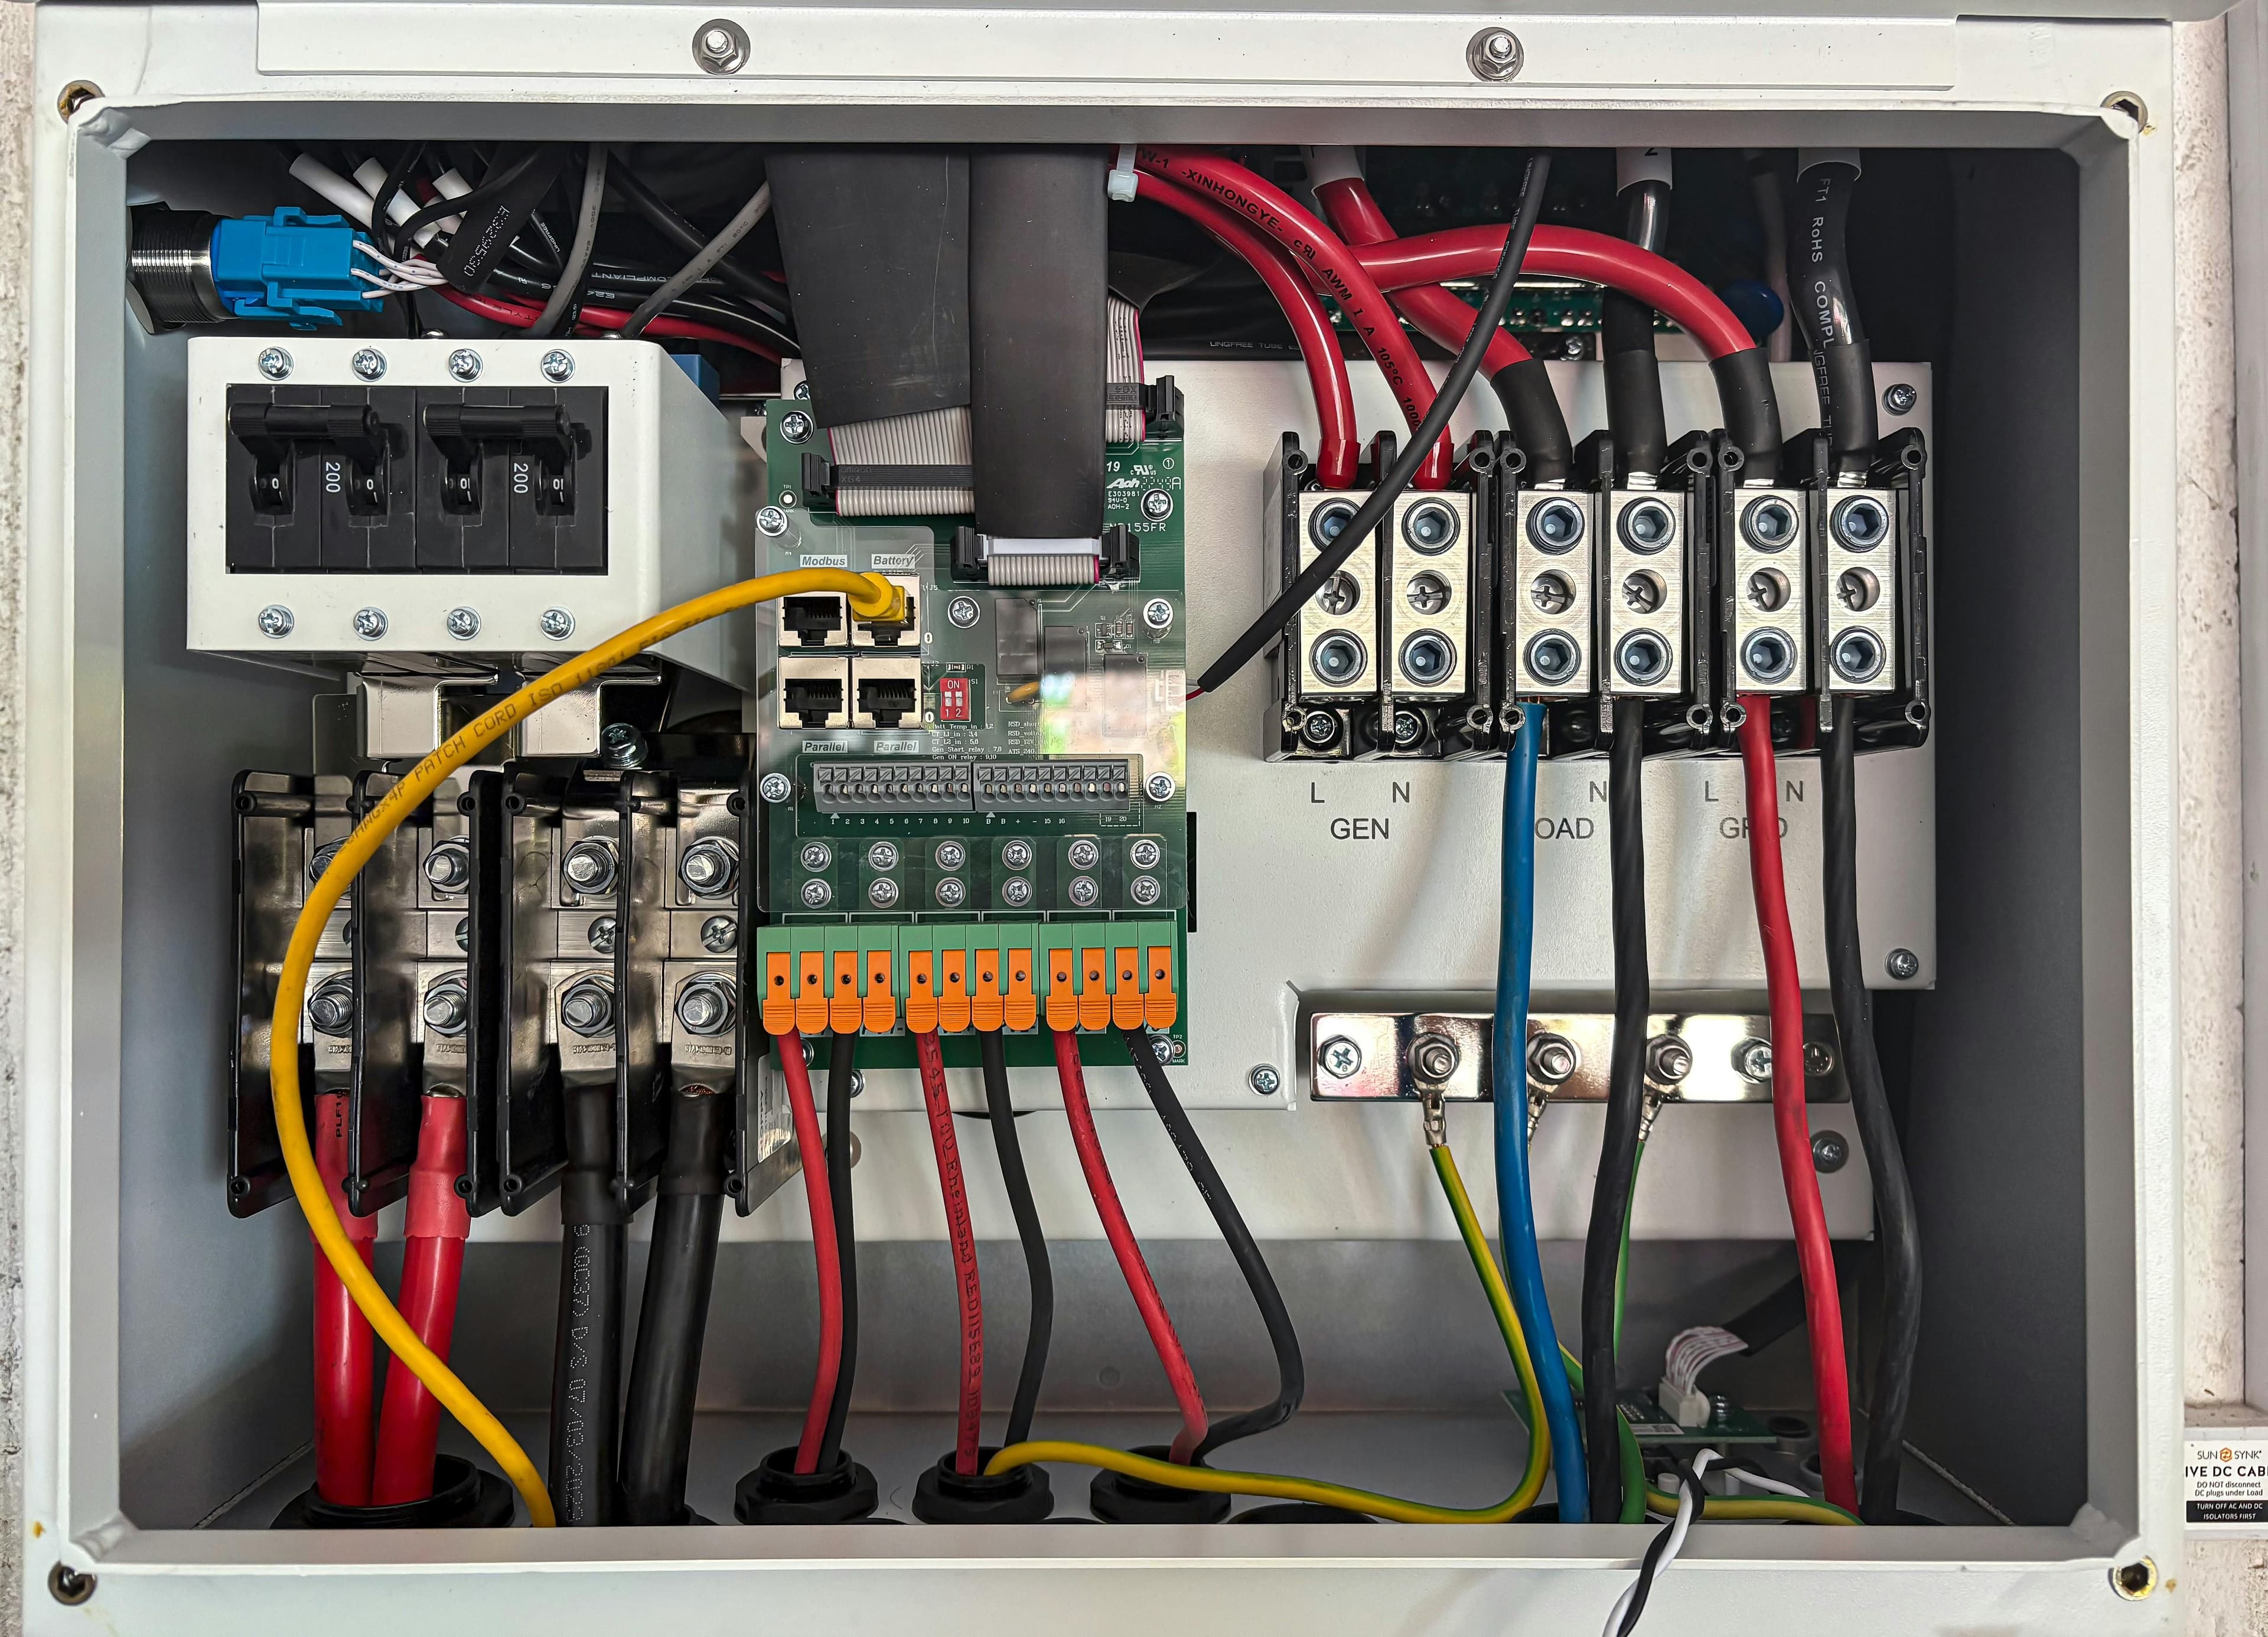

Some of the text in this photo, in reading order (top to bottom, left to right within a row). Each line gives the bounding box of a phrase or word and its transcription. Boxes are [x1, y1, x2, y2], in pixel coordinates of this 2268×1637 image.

[1816, 178, 1830, 202] FT1
[1811, 216, 1824, 263] RoHS
[591, 272, 672, 282] OMPLIANT
[1322, 268, 1353, 301] AWM
[1364, 326, 1376, 336] A
[1377, 347, 1403, 386] 105°C
[1106, 461, 1120, 472] 19
[325, 462, 340, 494] 200
[514, 462, 529, 494] 200
[802, 556, 845, 566] Modbus
[874, 556, 914, 567] Battery
[947, 680, 960, 689] ON
[945, 709, 962, 717] 1 2
[414, 735, 467, 782] PATCH
[472, 703, 517, 739] CORD
[530, 682, 563, 708] ISO
[804, 742, 845, 751] Parallel
[876, 742, 917, 751] Parallel
[1311, 782, 1410, 803] L N
[1589, 781, 1607, 803] N
[1705, 781, 1803, 802] L N
[1330, 818, 1389, 840] GEN
[1534, 817, 1594, 840] OAD
[2197, 1450, 2260, 1460] SUN SYNK
[2185, 1466, 2268, 1477] IVE DC CAB
[2206, 1489, 2224, 1498] plugs
